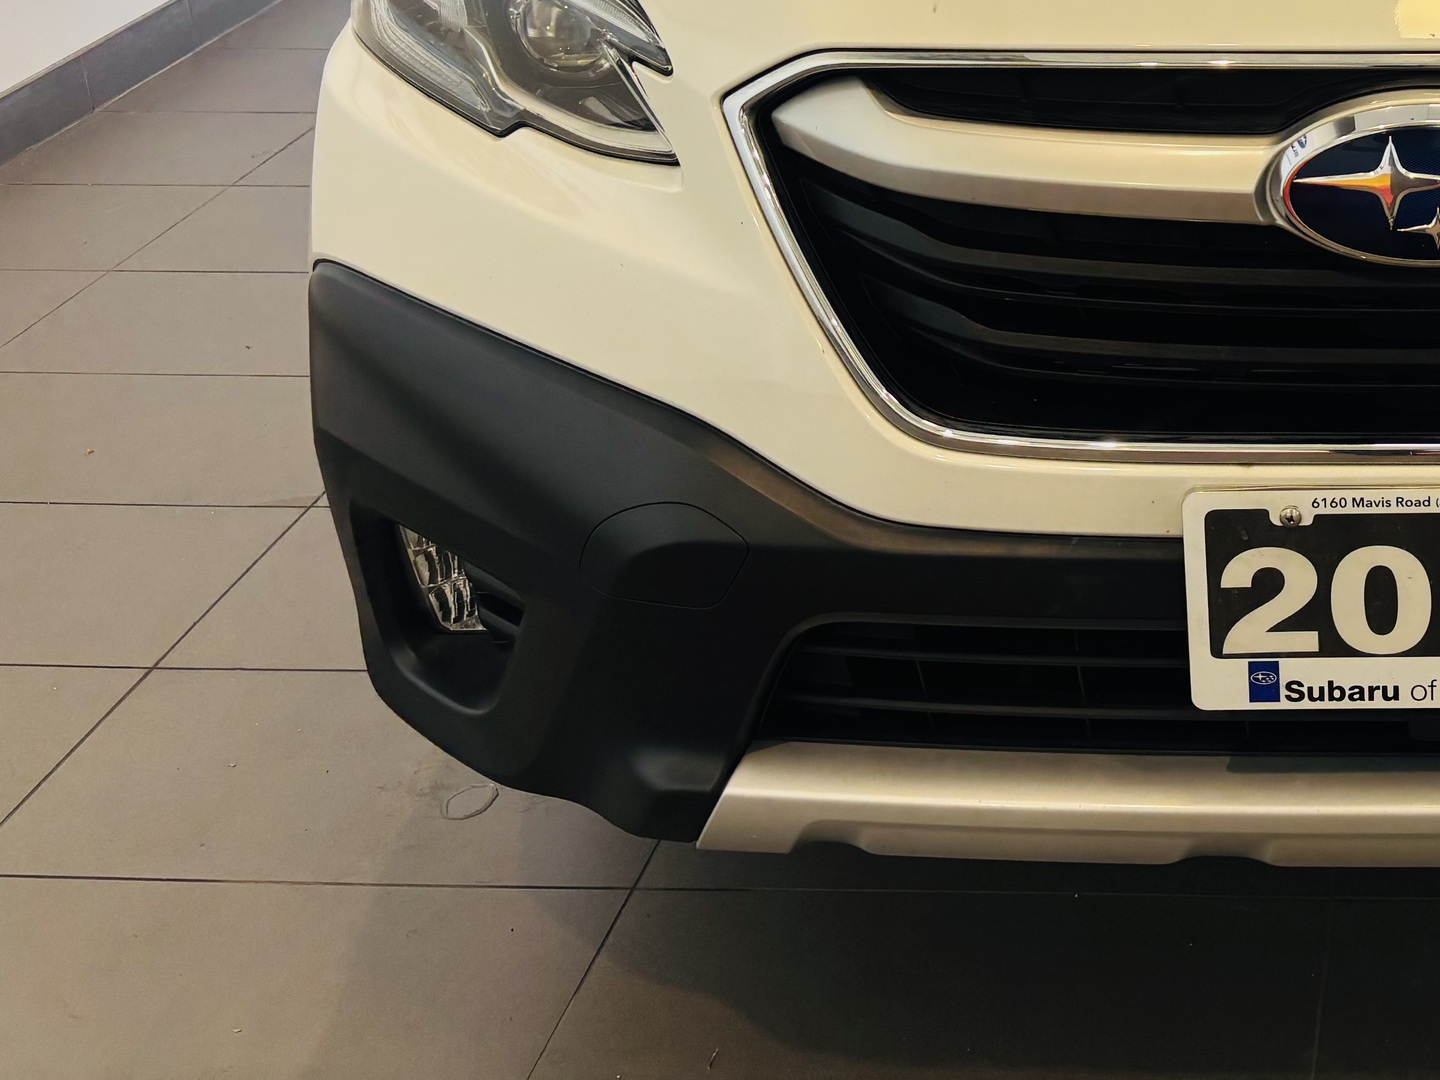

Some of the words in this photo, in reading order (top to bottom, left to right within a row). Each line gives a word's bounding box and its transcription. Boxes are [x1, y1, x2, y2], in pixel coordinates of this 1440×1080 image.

[1310, 497, 1348, 509] 6160
[1351, 496, 1392, 508] Mavis
[1396, 496, 1431, 508] Road
[1284, 679, 1400, 703] Subaru
[1410, 678, 1438, 702] of
